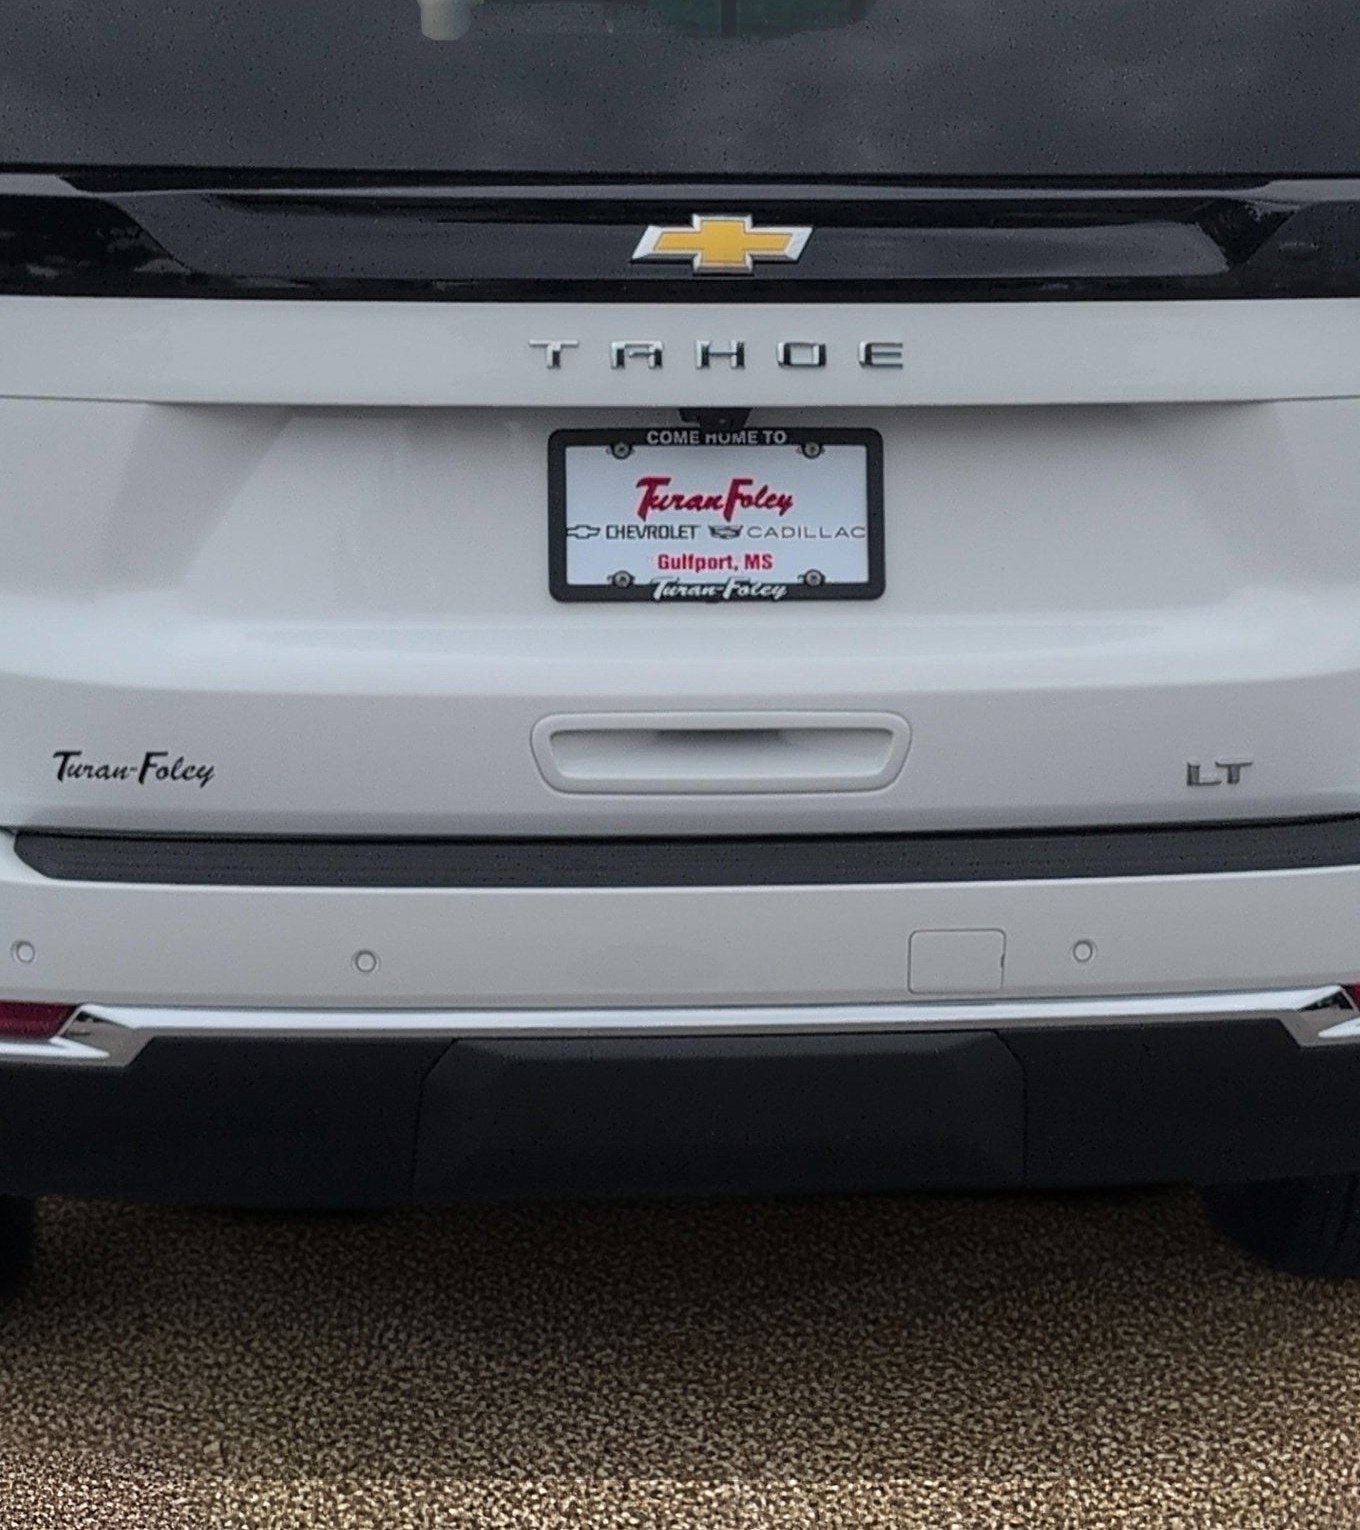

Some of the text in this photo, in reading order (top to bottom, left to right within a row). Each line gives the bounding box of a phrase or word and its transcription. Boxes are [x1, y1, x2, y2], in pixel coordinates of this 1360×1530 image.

[527, 338, 905, 370] TAHOE
[646, 429, 701, 445] COME
[762, 429, 789, 445] TO
[605, 523, 867, 541] CHEVROLET CADILLAC
[657, 552, 774, 574] Gulfport, MS
[1185, 756, 1255, 787] LT
